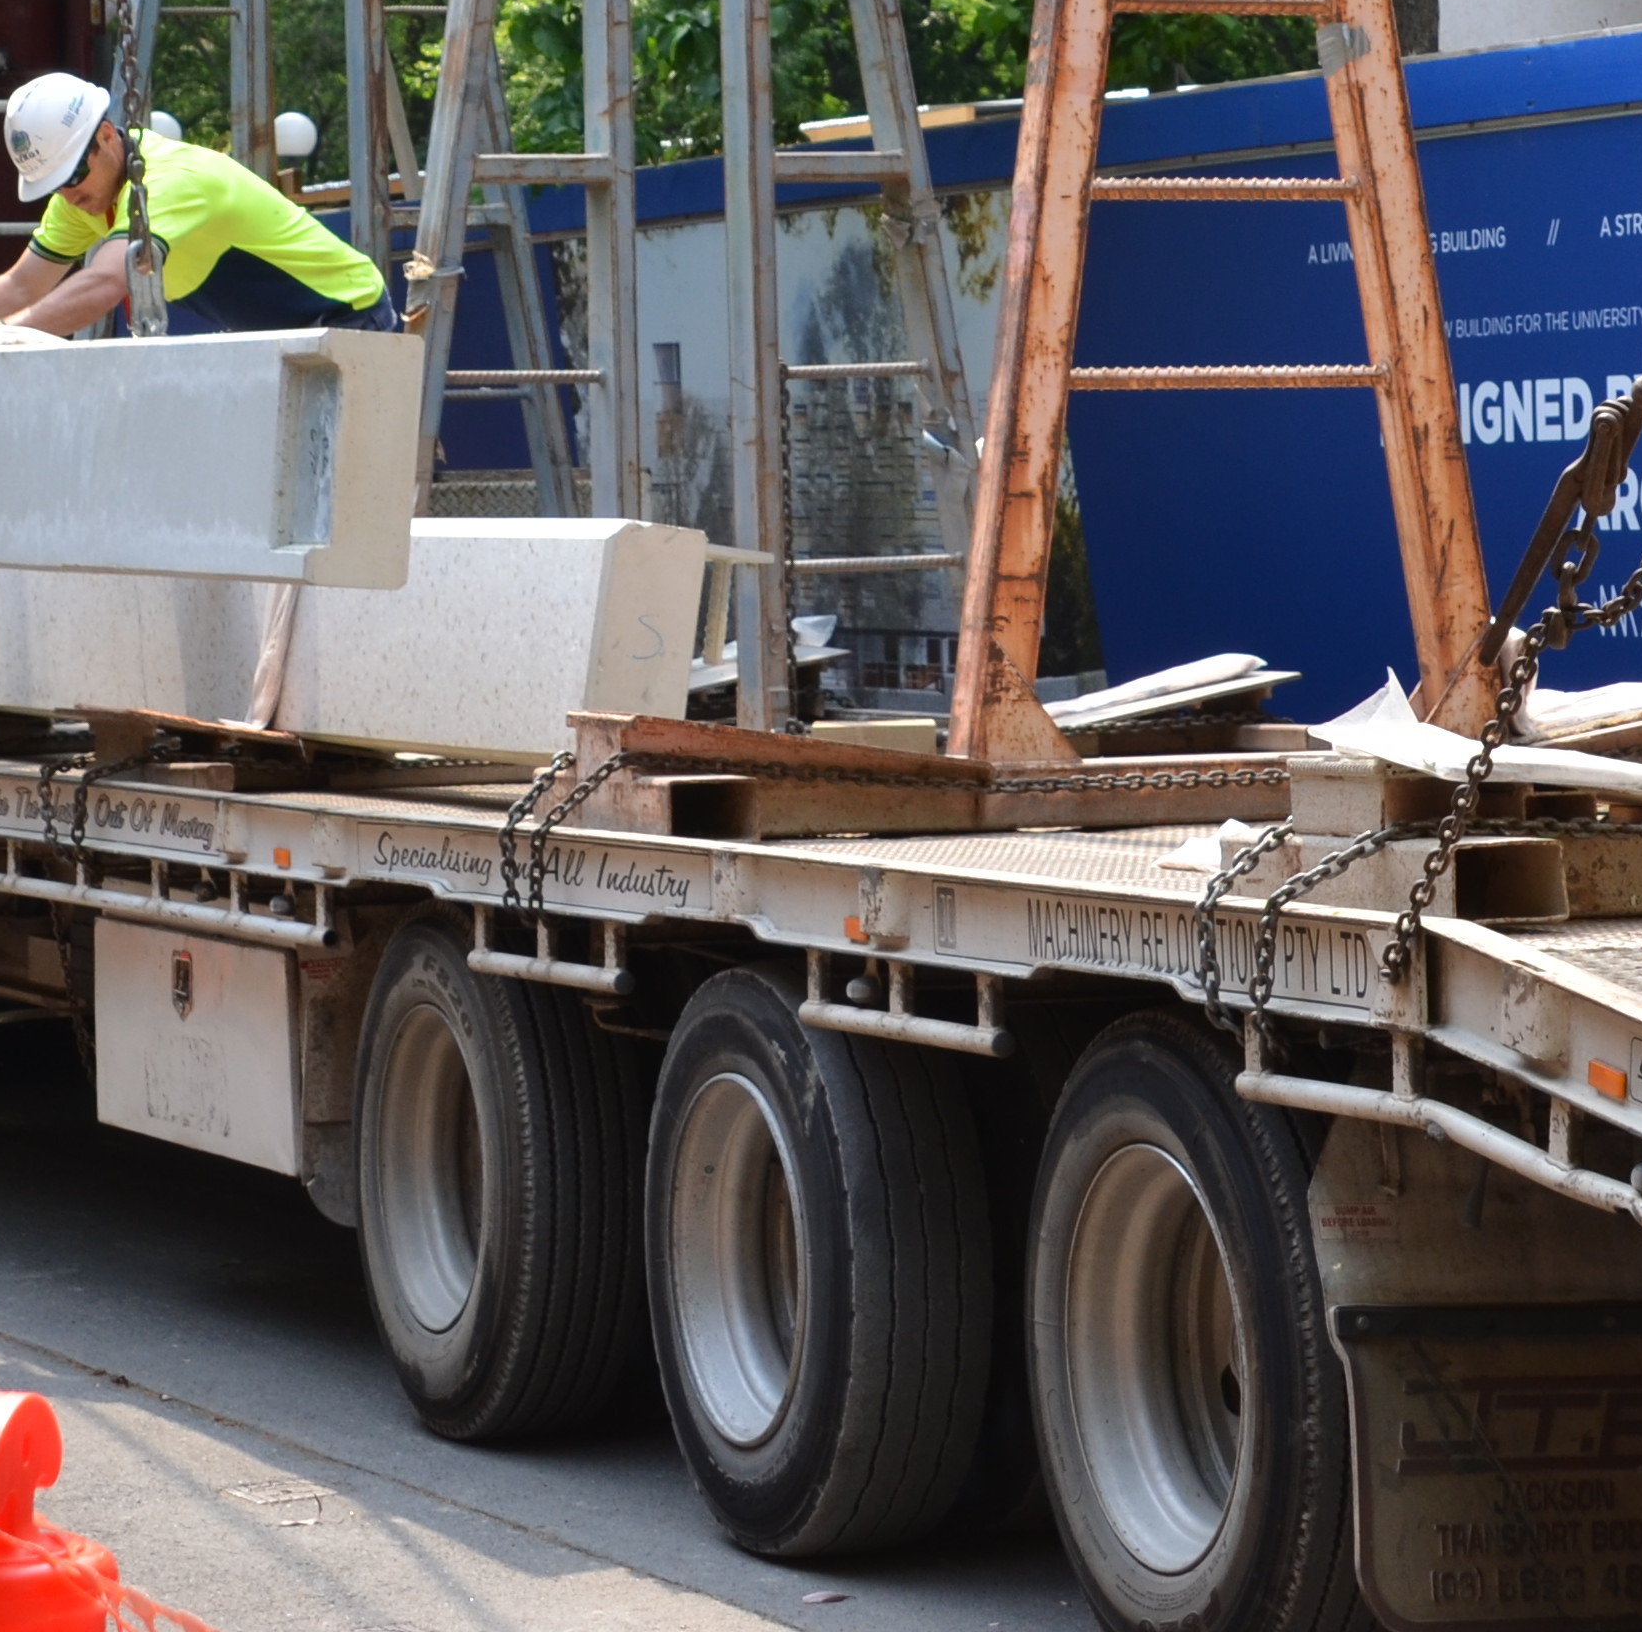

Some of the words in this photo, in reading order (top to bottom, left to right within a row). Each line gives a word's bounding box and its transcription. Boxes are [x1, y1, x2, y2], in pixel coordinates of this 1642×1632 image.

[1441, 226, 1506, 253] BUILDING
[1600, 216, 1612, 239] A
[1307, 244, 1318, 264] A
[1455, 312, 1515, 339] BUILDING
[1516, 309, 1543, 335] FOR
[1545, 307, 1570, 331] THE
[94, 793, 128, 830] Out
[129, 797, 158, 834] Of
[159, 802, 215, 851] Moving
[374, 830, 493, 887] Specialising
[542, 847, 584, 888] All
[596, 852, 692, 909] Industry
[1027, 897, 1133, 966] MACHINERY
[1283, 924, 1321, 993] PTY
[1328, 928, 1368, 999] LTD
[1493, 1476, 1616, 1514] JACKSON
